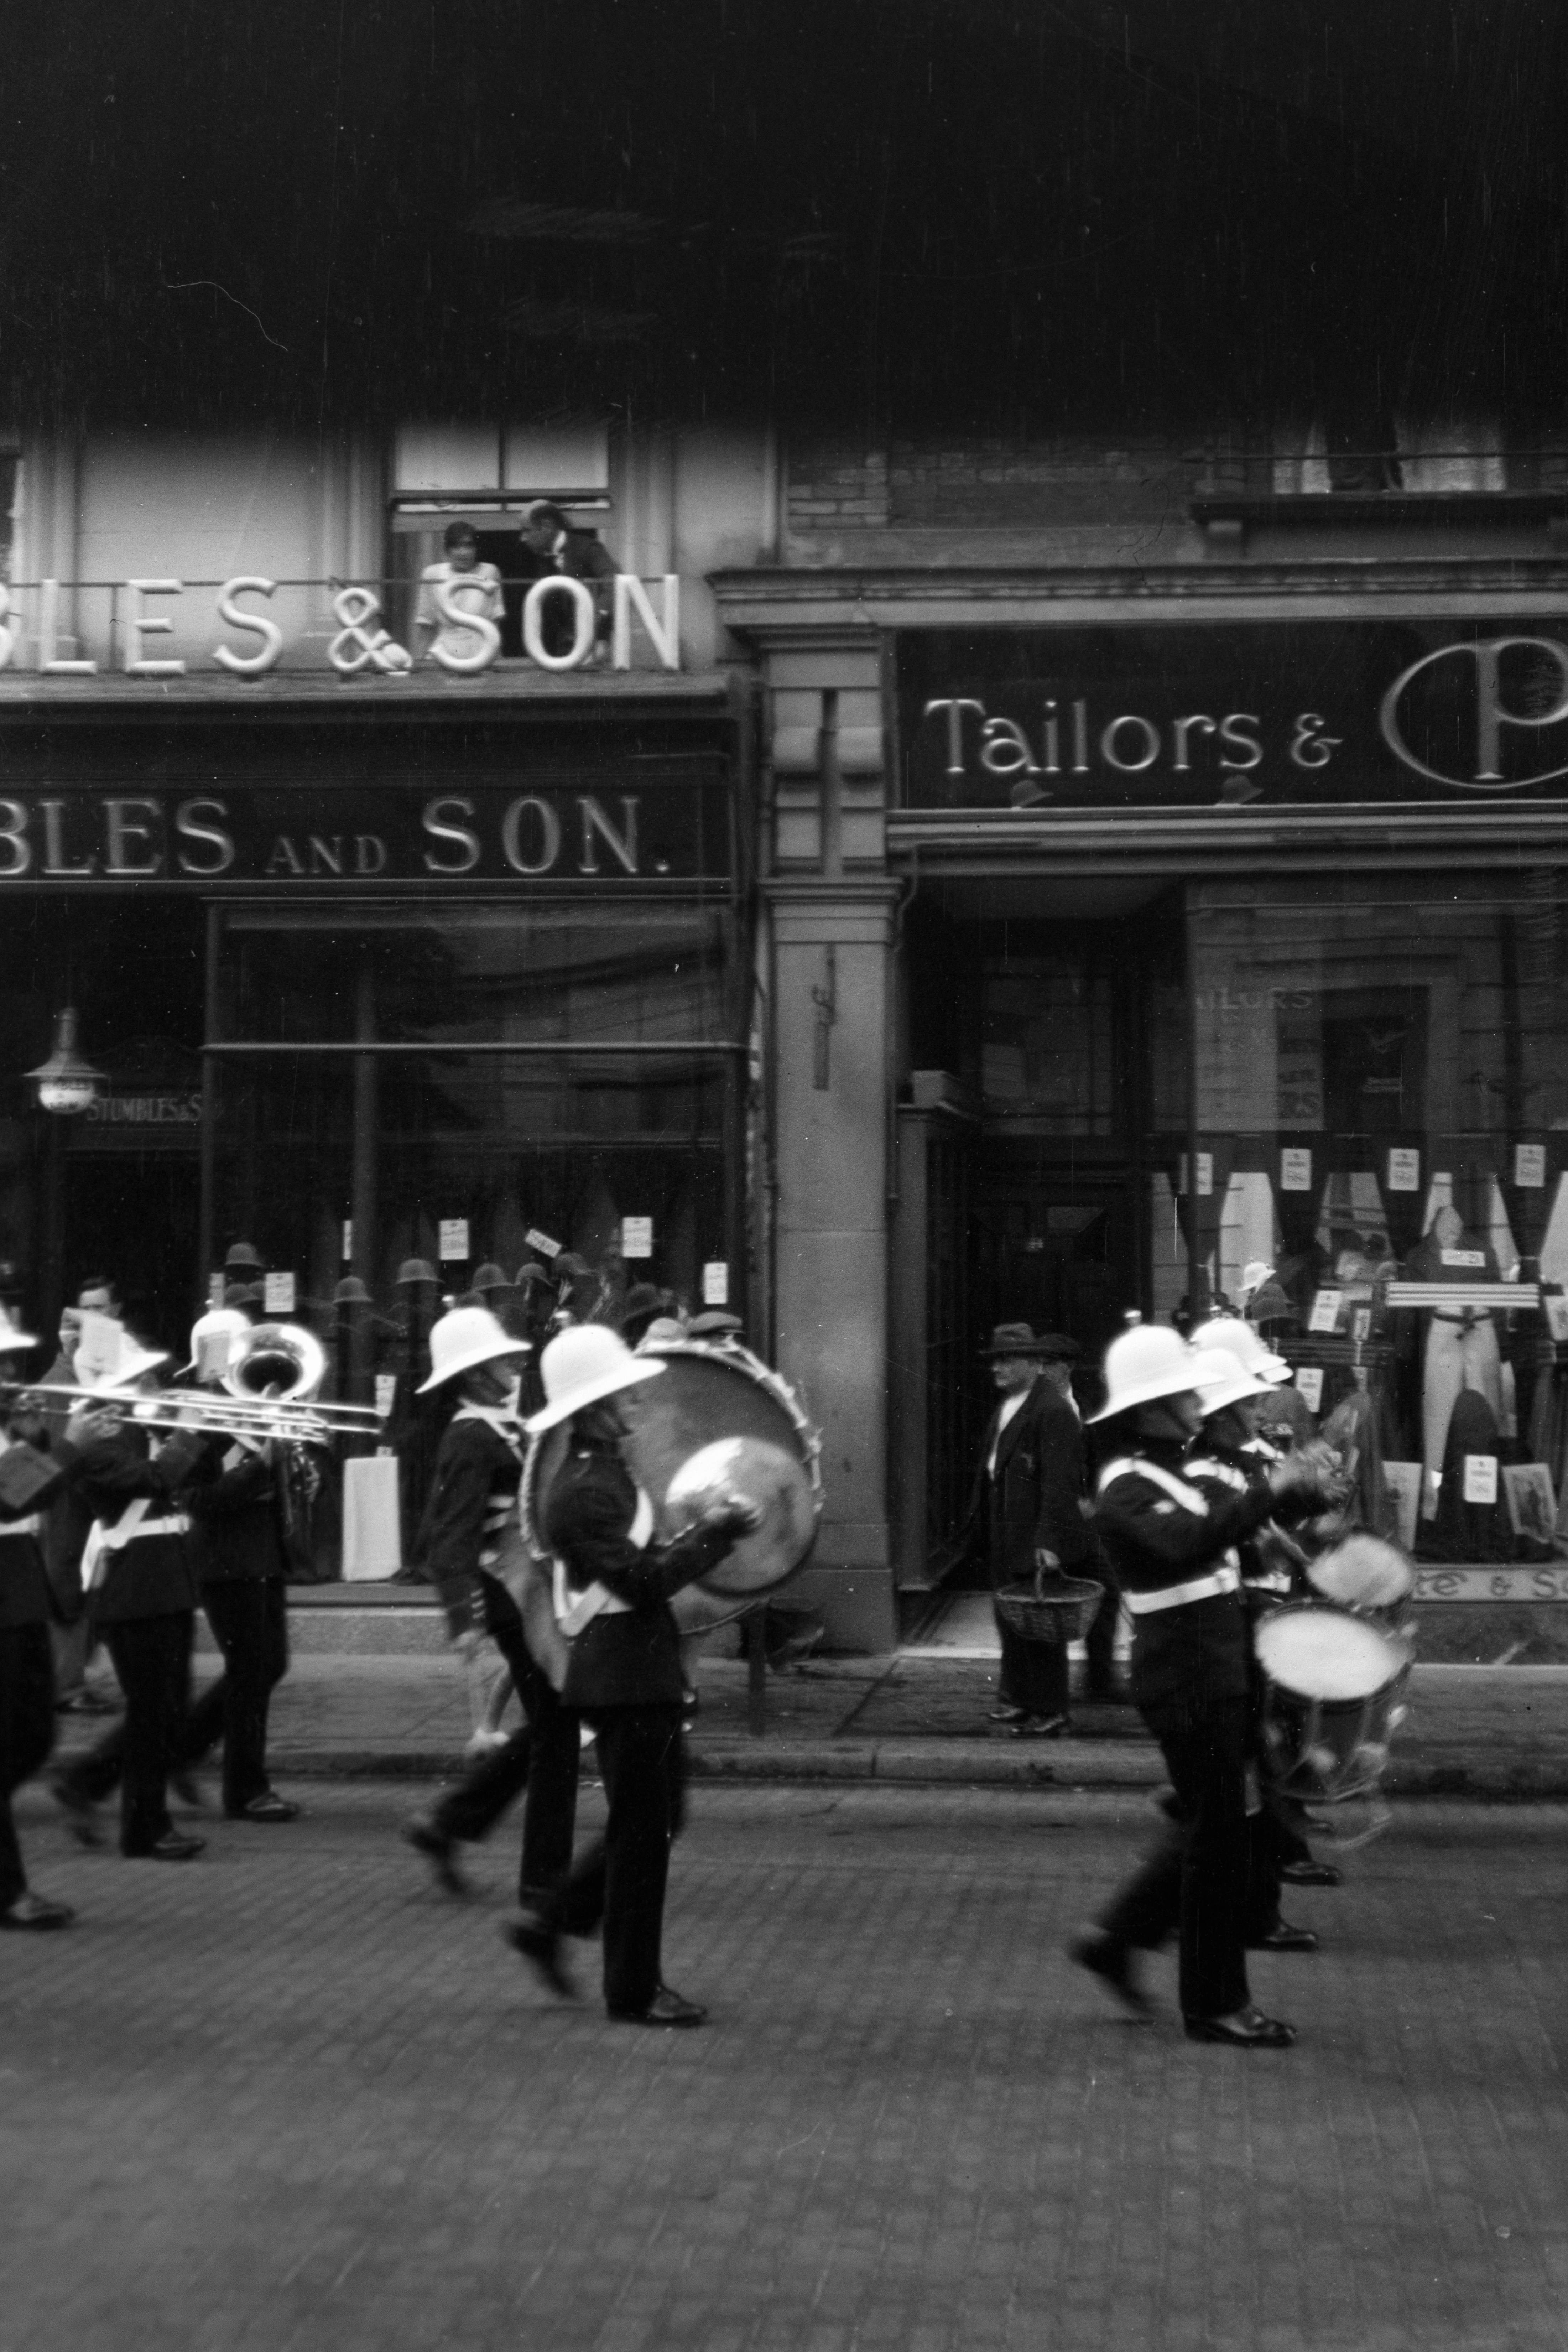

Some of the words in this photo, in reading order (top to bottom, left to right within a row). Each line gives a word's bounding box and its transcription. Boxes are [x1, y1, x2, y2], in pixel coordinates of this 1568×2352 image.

[0, 576, 282, 674] LES
[327, 587, 402, 672] &
[429, 574, 680, 672] SON
[924, 698, 1264, 774] Tailors
[1291, 712, 1344, 769] &
[264, 836, 386, 874] AND
[422, 795, 669, 874] SON.
